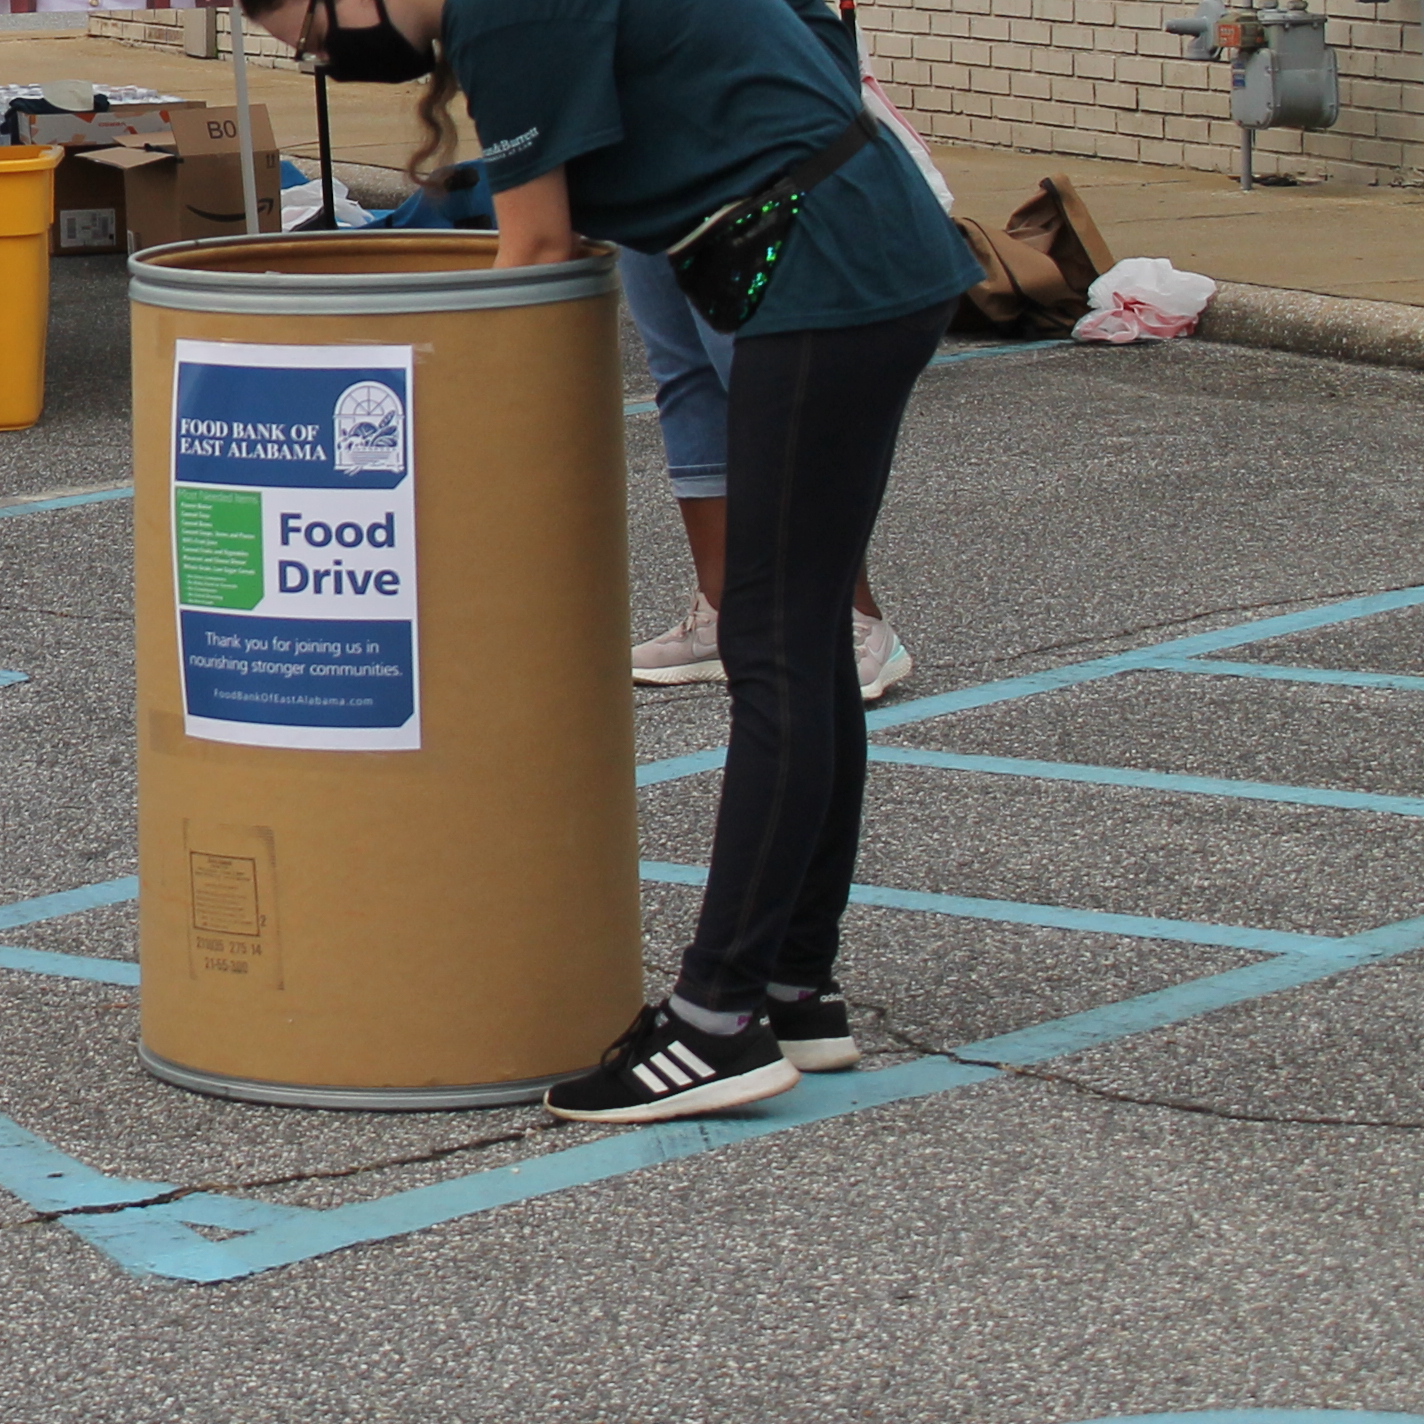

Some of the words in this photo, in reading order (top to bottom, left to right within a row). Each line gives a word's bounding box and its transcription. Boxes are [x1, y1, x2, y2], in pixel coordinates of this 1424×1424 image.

[180, 418, 228, 437] FOOD
[232, 422, 286, 441] BANK
[290, 424, 320, 441] OF
[180, 437, 224, 456] EAST
[227, 441, 327, 461] ALABAMA
[280, 512, 395, 548] Food
[278, 559, 400, 595] Drive
[205, 631, 242, 649] Thank
[245, 638, 268, 653] you
[272, 636, 291, 652] for
[294, 638, 341, 657] joining
[346, 642, 362, 654] us
[366, 639, 379, 654] in
[189, 654, 248, 675] nourishing
[251, 660, 305, 678] stronger
[309, 662, 403, 677] communities.
[214, 688, 373, 706] FoodBankOfEastAlabama.com
